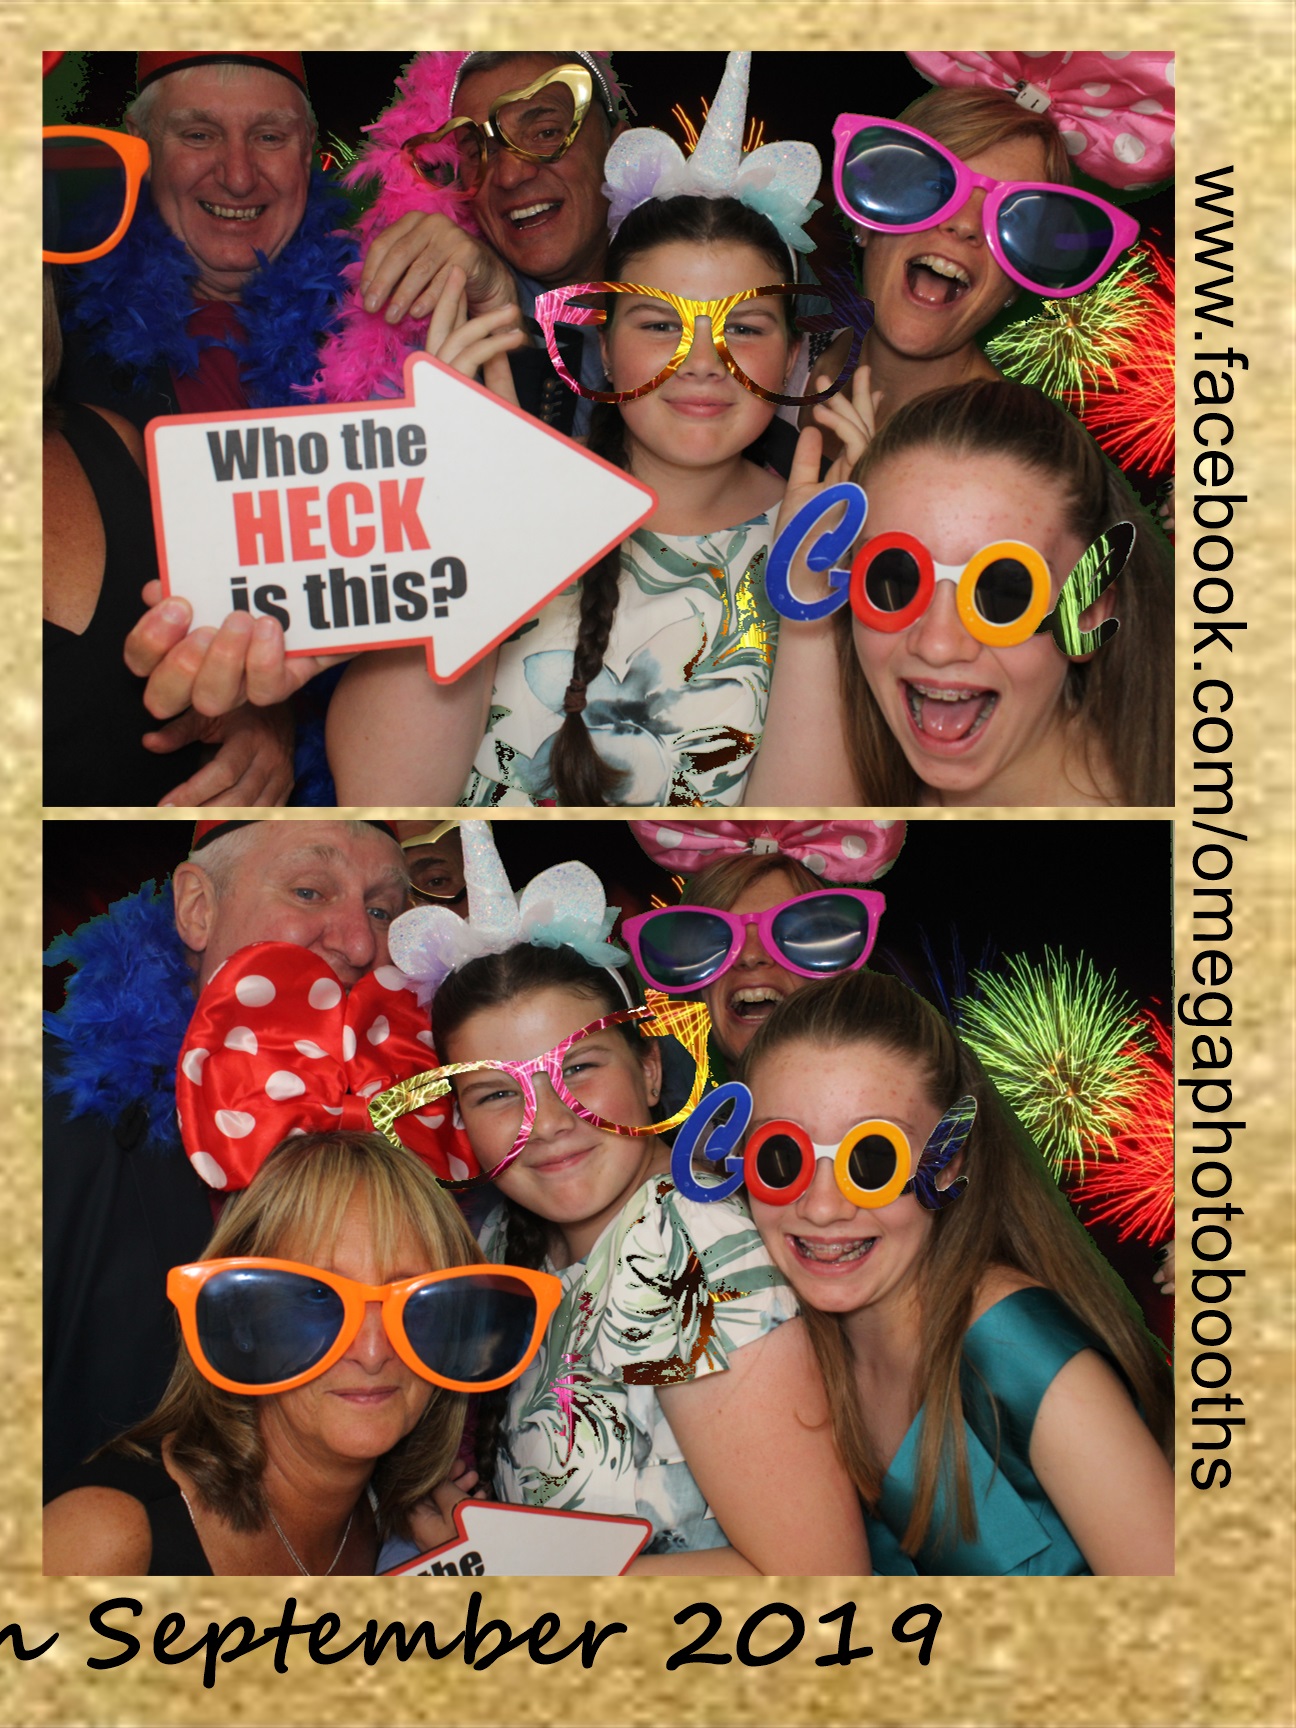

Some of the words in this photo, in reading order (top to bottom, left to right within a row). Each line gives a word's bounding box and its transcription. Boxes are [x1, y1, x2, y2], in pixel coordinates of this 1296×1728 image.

[207, 426, 329, 482] Who
[340, 419, 427, 470] the
[233, 477, 431, 567] HECK
[230, 576, 291, 633] is
[304, 556, 468, 630] this?
